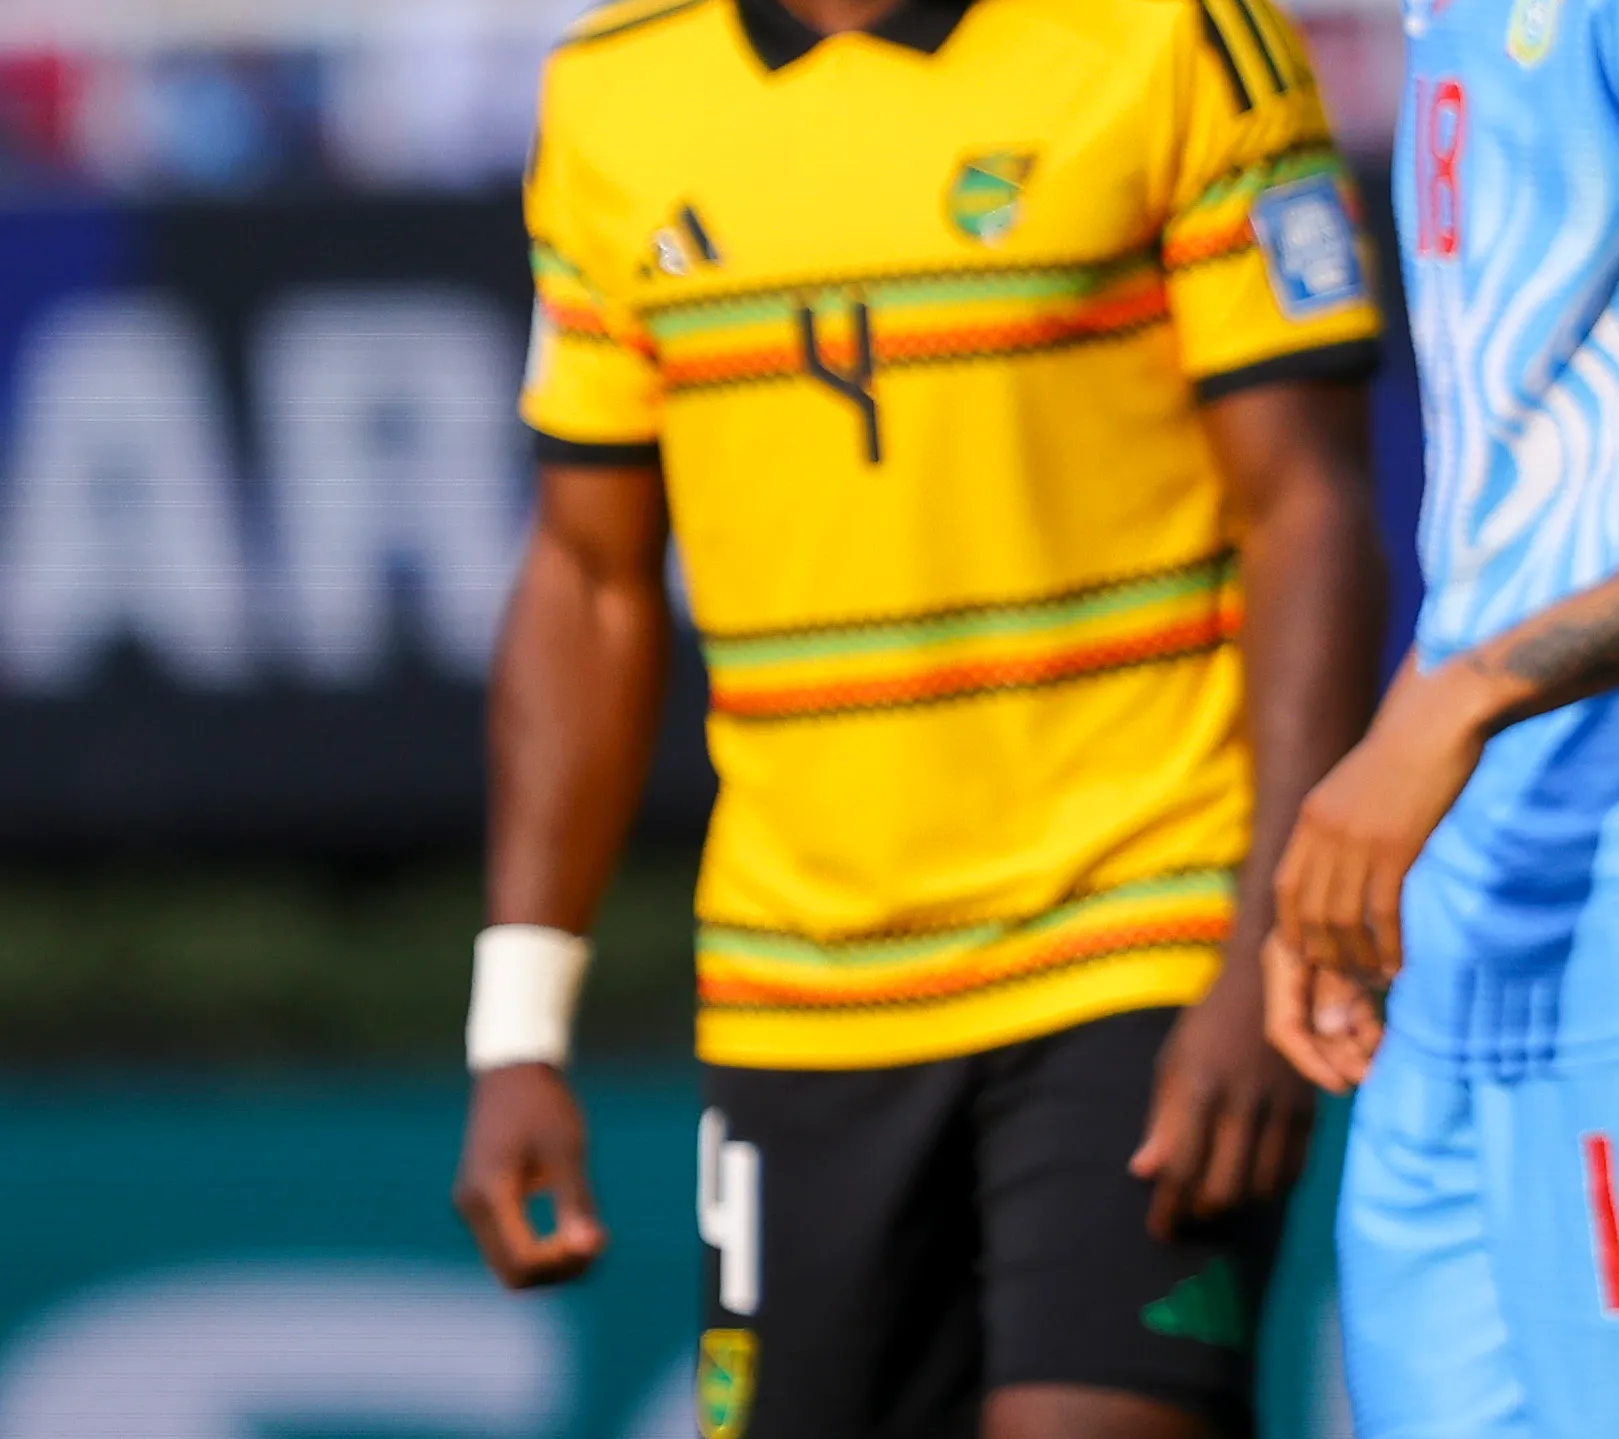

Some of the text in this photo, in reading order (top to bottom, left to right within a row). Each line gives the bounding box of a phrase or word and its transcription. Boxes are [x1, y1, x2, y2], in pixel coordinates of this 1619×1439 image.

[0, 280, 540, 695] AR
[795, 298, 884, 468] 4
[695, 1105, 762, 1316] 4
